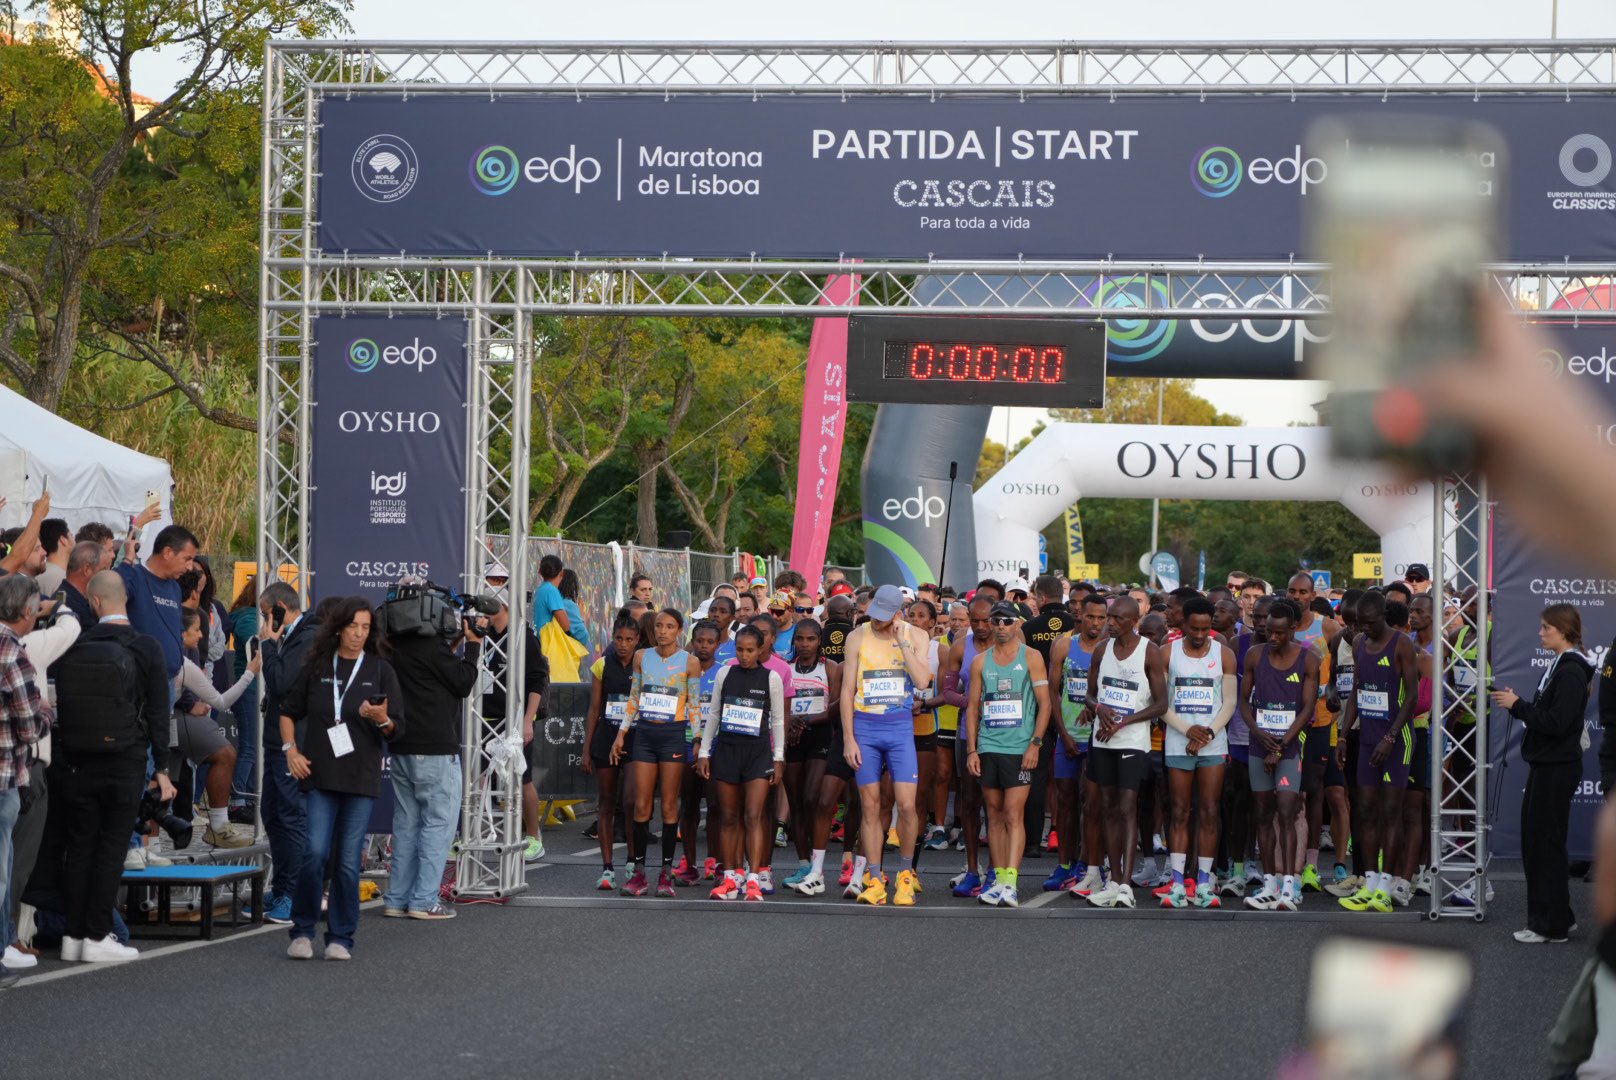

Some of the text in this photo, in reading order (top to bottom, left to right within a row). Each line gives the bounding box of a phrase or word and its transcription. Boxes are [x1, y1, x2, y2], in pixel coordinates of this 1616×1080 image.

[812, 129, 1139, 160] PARTIDA START
[638, 145, 763, 169] Maratona
[524, 144, 602, 194] edp
[1247, 144, 1328, 195] edp
[637, 174, 760, 196] de Lisboa
[893, 179, 1056, 208] CASCAIS
[1552, 199, 1616, 210] CLASSICS
[920, 216, 1031, 230] Para toda a vida
[1189, 276, 1336, 363] edp
[382, 337, 437, 373] edp
[910, 344, 1063, 383] 0:00:00
[1567, 346, 1616, 384] edp
[338, 410, 441, 433] OYSHO
[1116, 441, 1307, 481] OYSHO
[371, 470, 407, 497] ipdj
[1002, 483, 1060, 496] OYSHO
[882, 486, 945, 528] edp
[1068, 503, 1083, 555] WAV
[1363, 556, 1381, 564] WAV
[345, 561, 429, 577] CASCAIS
[1373, 565, 1382, 576] B
[1529, 579, 1616, 595] CASCAIS
[1457, 670, 1465, 683] 7
[869, 683, 892, 691] PACER
[1069, 682, 1087, 691] MUR
[645, 696, 672, 708] TILAHUN
[1105, 690, 1131, 703] PACER 2
[1176, 690, 1211, 700] GEMEDA
[1361, 695, 1377, 704] PACER
[611, 705, 626, 715] FEL
[794, 700, 812, 713] 57
[988, 704, 1017, 714] FERREIRA
[726, 708, 758, 722] AFEWORK
[1263, 713, 1284, 724] PACER
